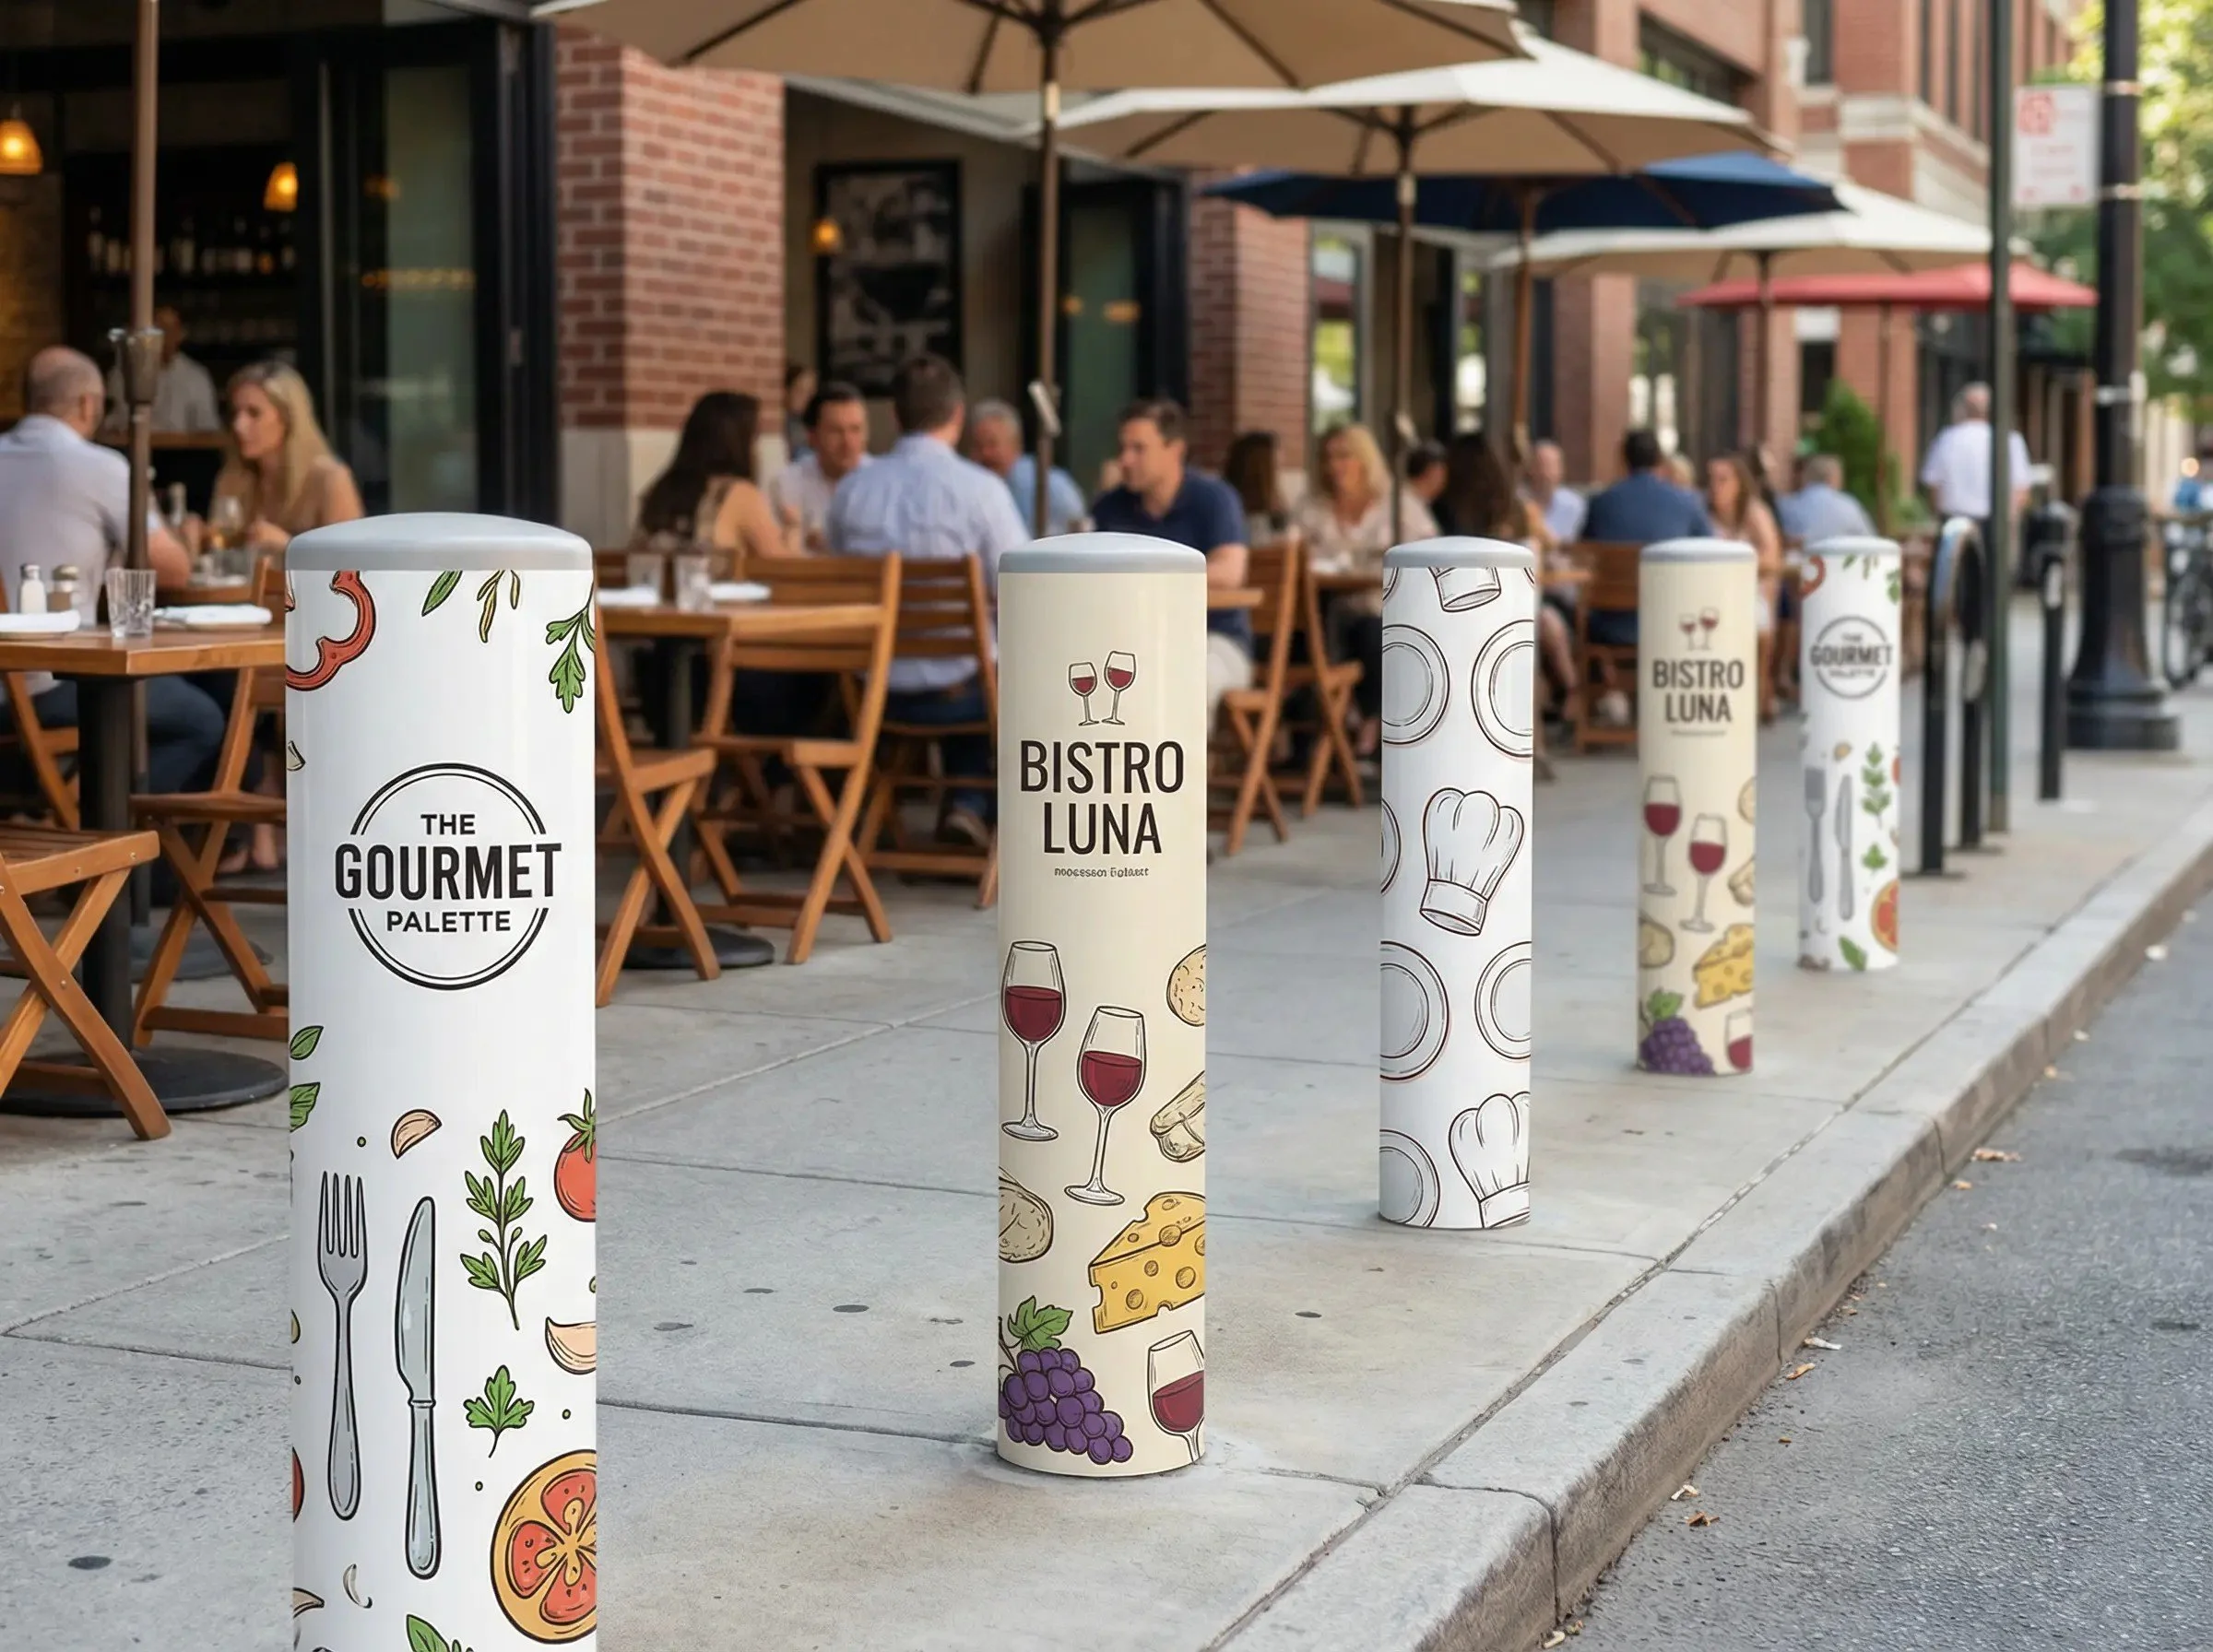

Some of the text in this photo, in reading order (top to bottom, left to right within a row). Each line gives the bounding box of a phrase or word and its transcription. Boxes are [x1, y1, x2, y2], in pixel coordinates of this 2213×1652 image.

[1810, 644, 1893, 666] GOURMET
[1652, 659, 1745, 689] BISTRO
[1665, 693, 1733, 723] LUNA
[1021, 740, 1184, 794] BISTRO
[420, 814, 476, 835] THE
[1044, 802, 1162, 855] LUNA
[335, 843, 562, 901] GOURMET
[386, 911, 511, 933] PALETTE
